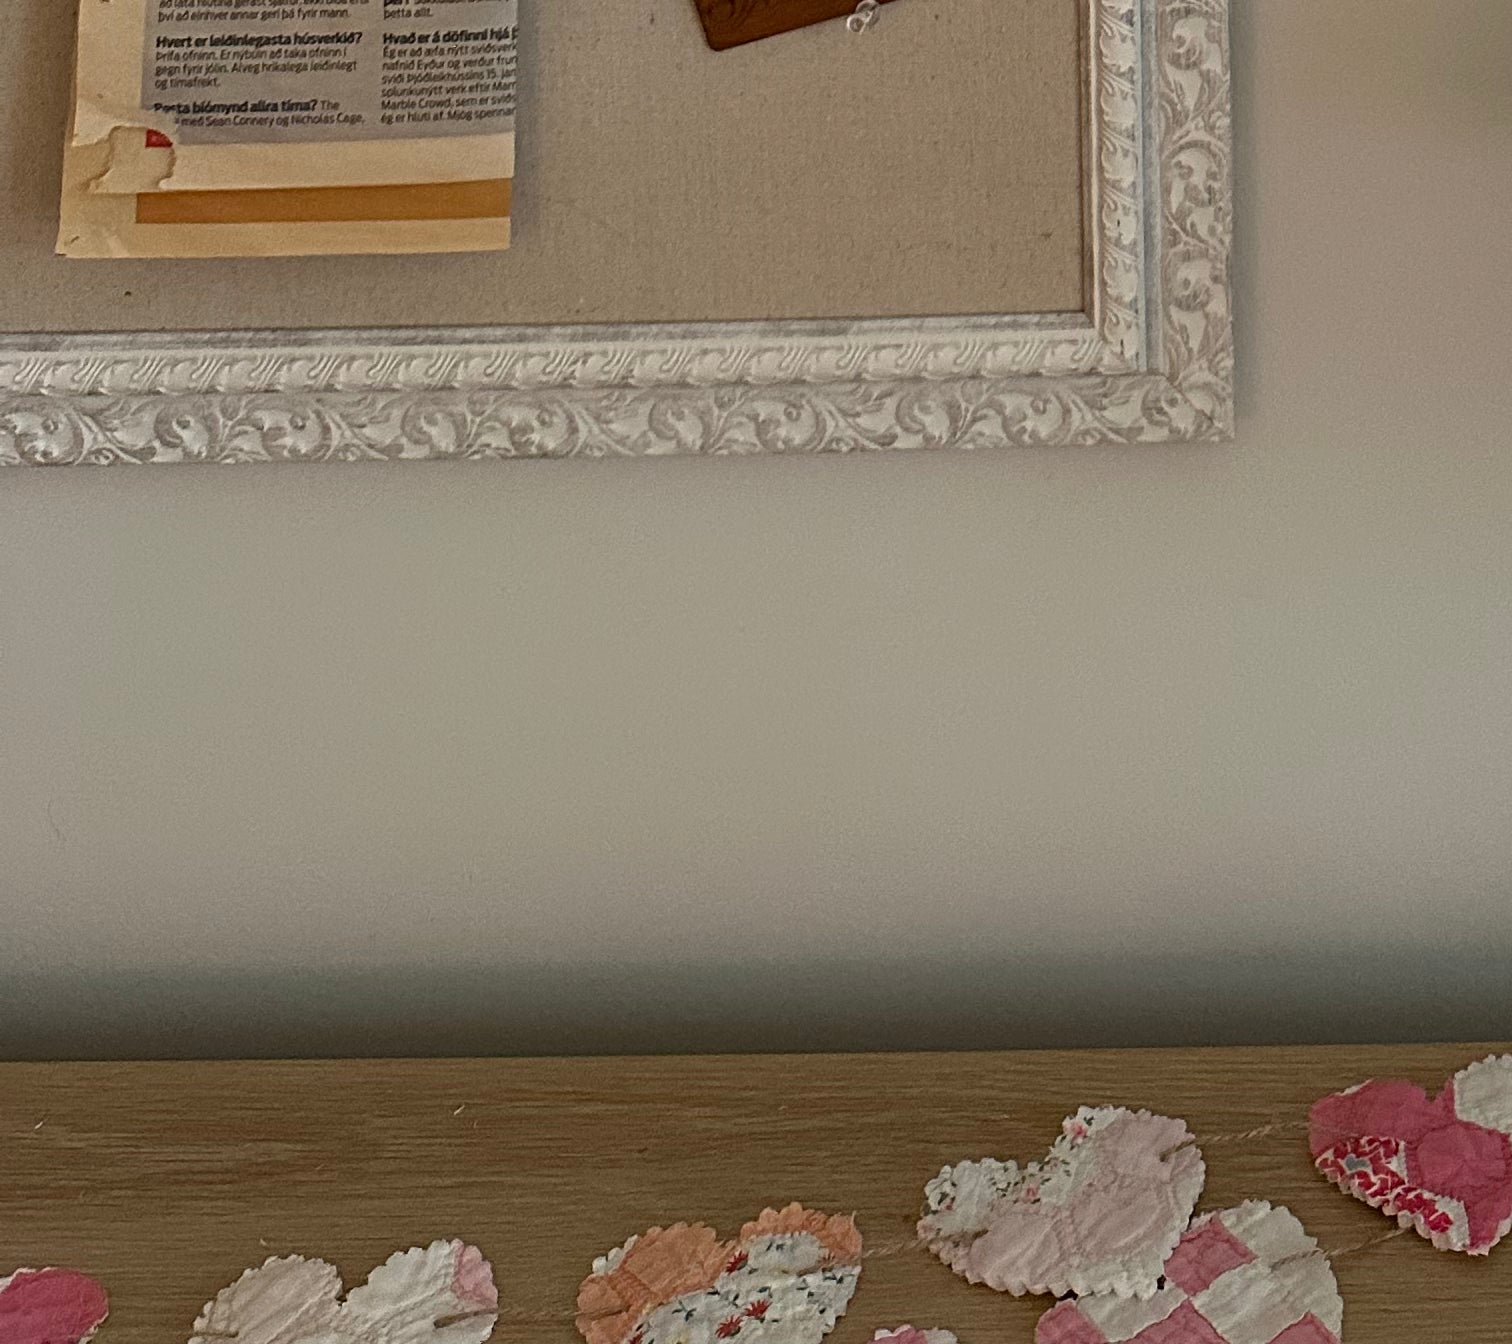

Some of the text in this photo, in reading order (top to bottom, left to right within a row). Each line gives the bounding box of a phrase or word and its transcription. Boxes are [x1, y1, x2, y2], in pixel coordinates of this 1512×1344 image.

[155, 31, 362, 49] Hvert er leiðinlegasta húsverkið?
[383, 26, 510, 44] Hvað er á döfinni hjá
[250, 100, 279, 112] allra
[281, 99, 317, 111] tíma?
